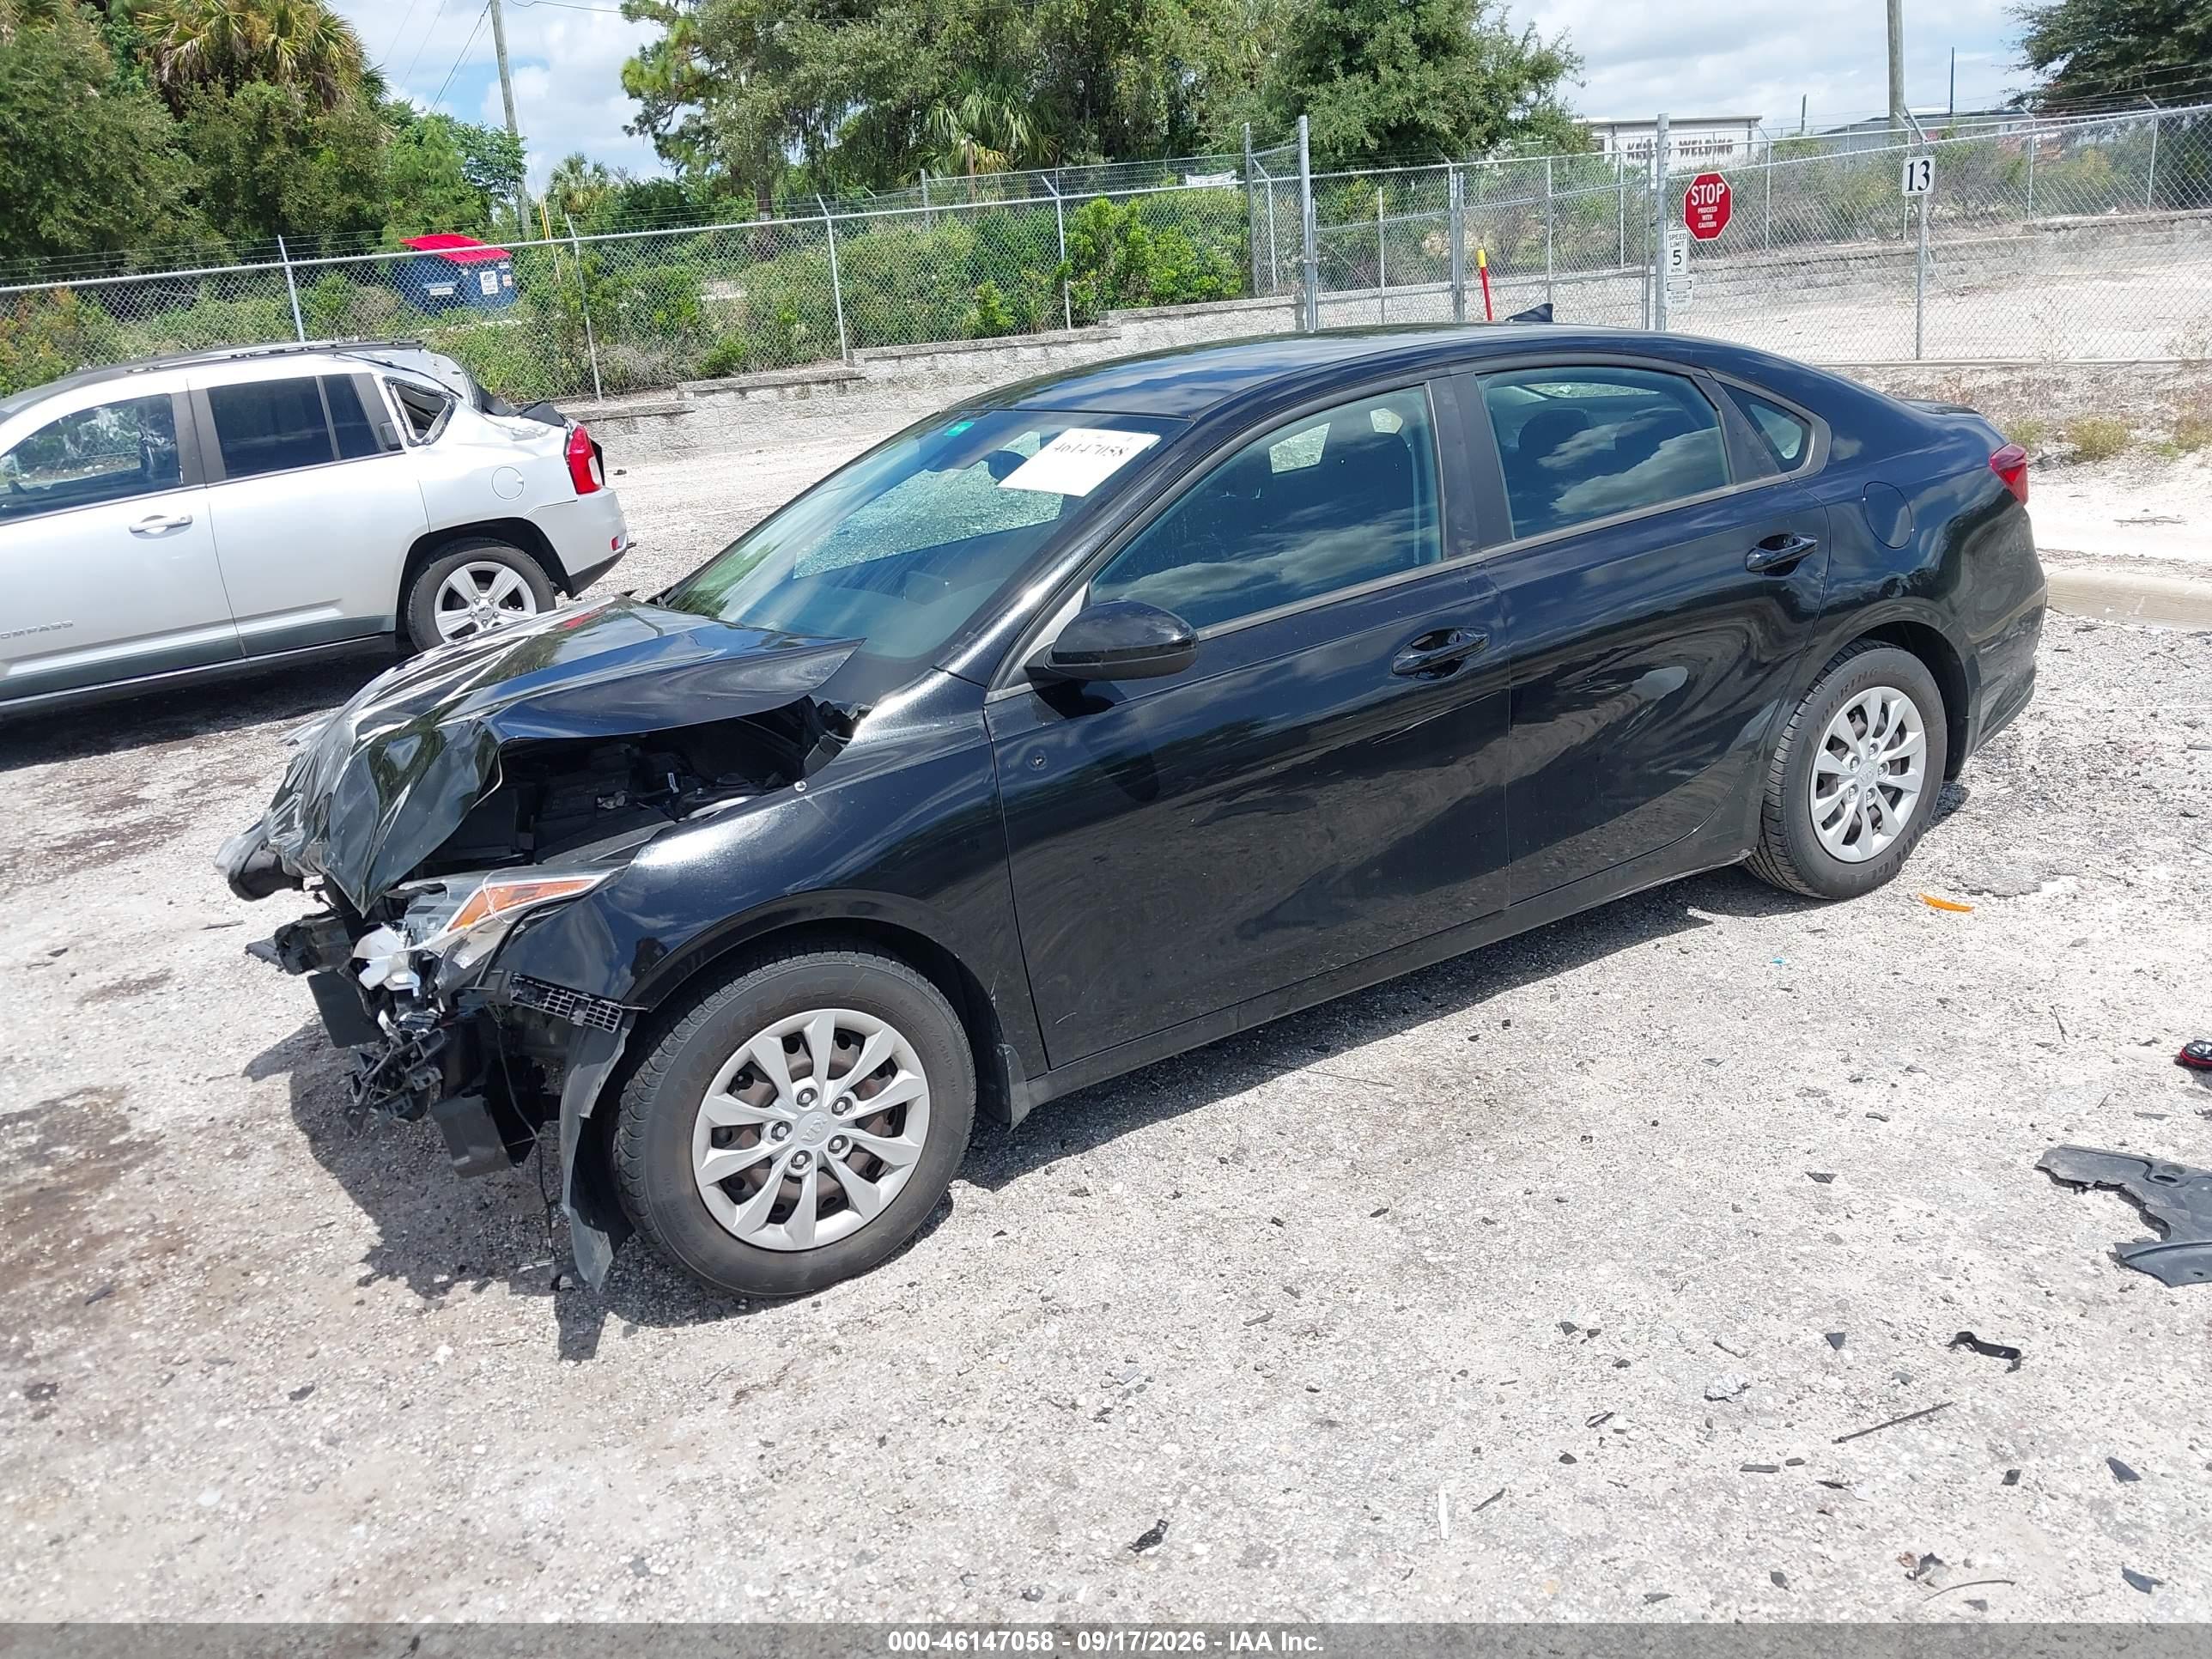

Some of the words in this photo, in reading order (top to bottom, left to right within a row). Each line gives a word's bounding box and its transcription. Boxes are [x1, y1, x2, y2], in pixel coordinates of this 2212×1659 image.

[1905, 160, 1930, 191] 13
[1691, 182, 1725, 206] STOP
[1668, 233, 1687, 241] SPEED
[1672, 249, 1682, 266] 5
